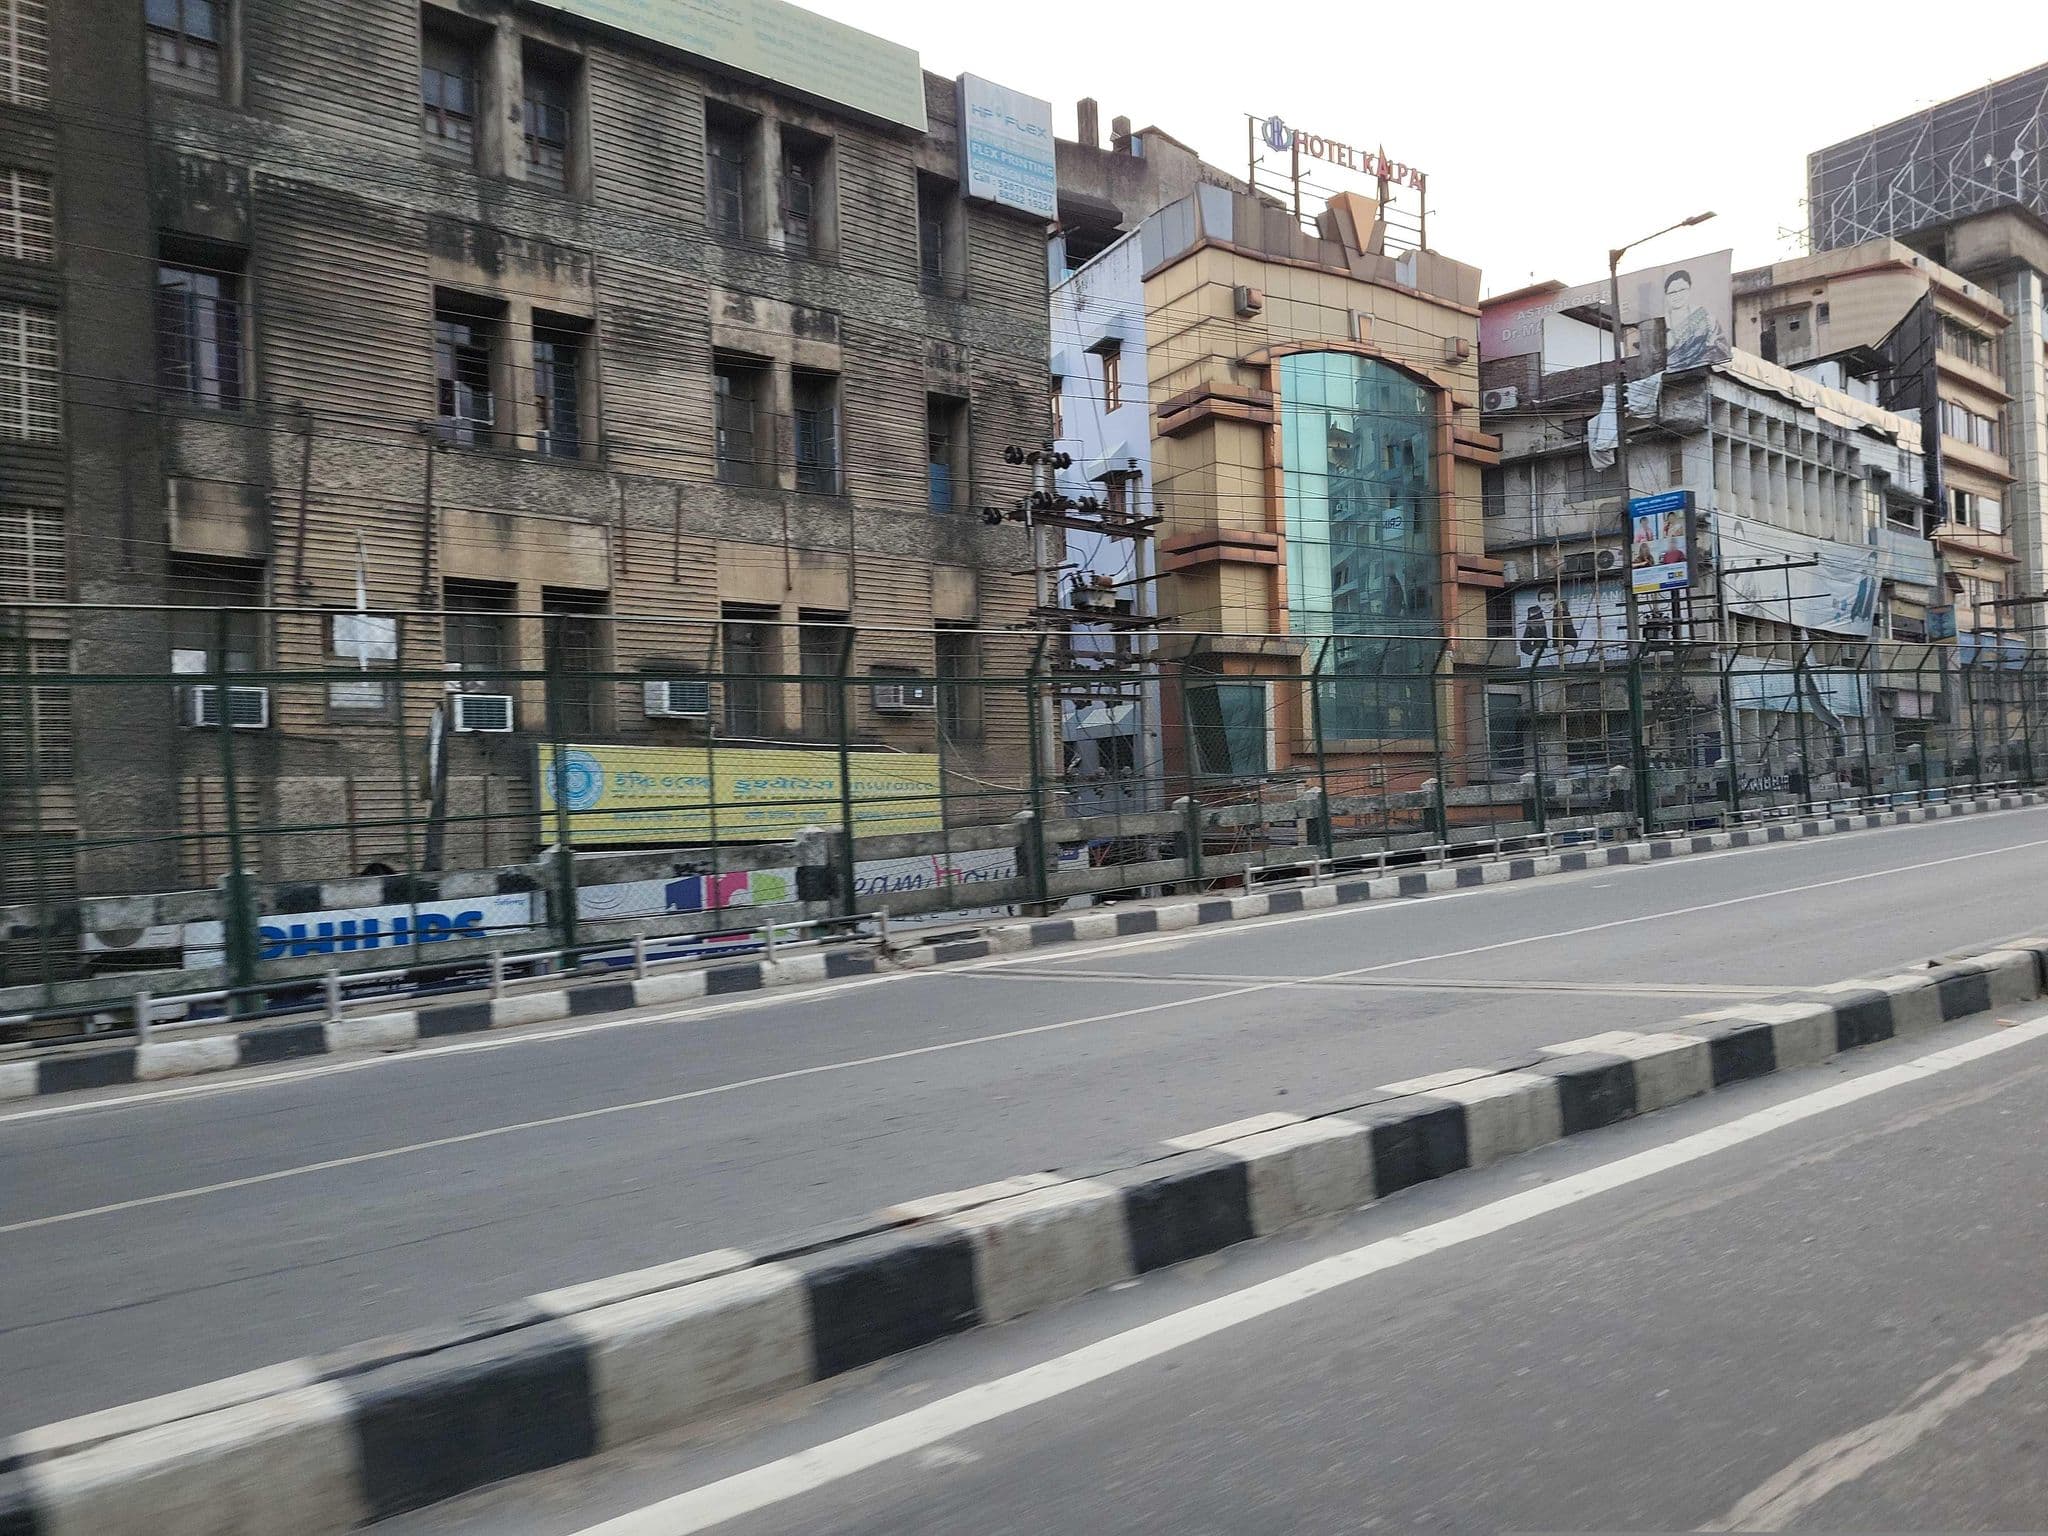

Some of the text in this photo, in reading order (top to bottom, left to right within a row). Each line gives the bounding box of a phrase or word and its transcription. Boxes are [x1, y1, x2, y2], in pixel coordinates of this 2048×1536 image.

[1005, 114, 1047, 139] FLEX
[971, 142, 998, 160] FLEX
[1002, 152, 1053, 177] PRINTING
[1295, 129, 1424, 190] HOTEL KALPA
[1518, 290, 1612, 320] ASTROLOGER
